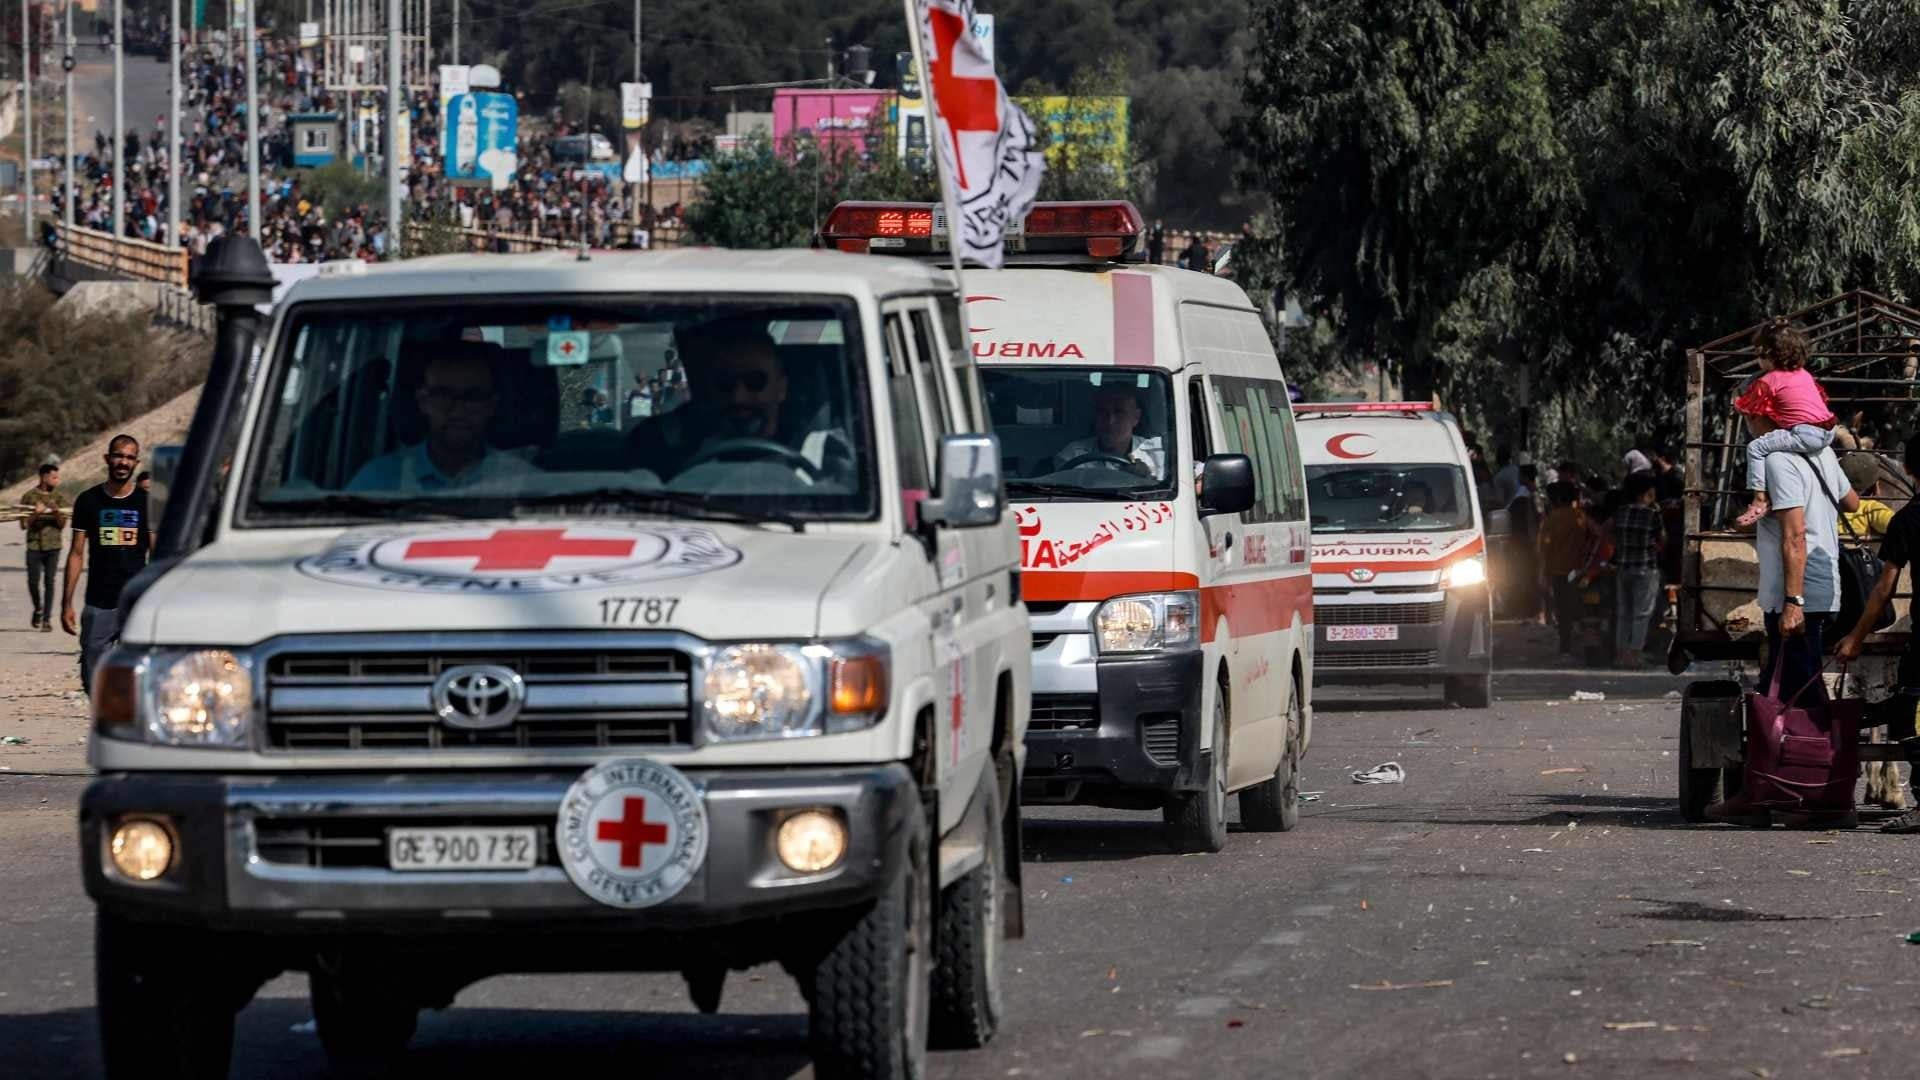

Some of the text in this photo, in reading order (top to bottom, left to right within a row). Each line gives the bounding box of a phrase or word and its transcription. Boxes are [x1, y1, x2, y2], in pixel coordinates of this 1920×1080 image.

[599, 599, 681, 623] 17787
[604, 765, 698, 869] INTERNATIONAL
[487, 834, 530, 862] 732
